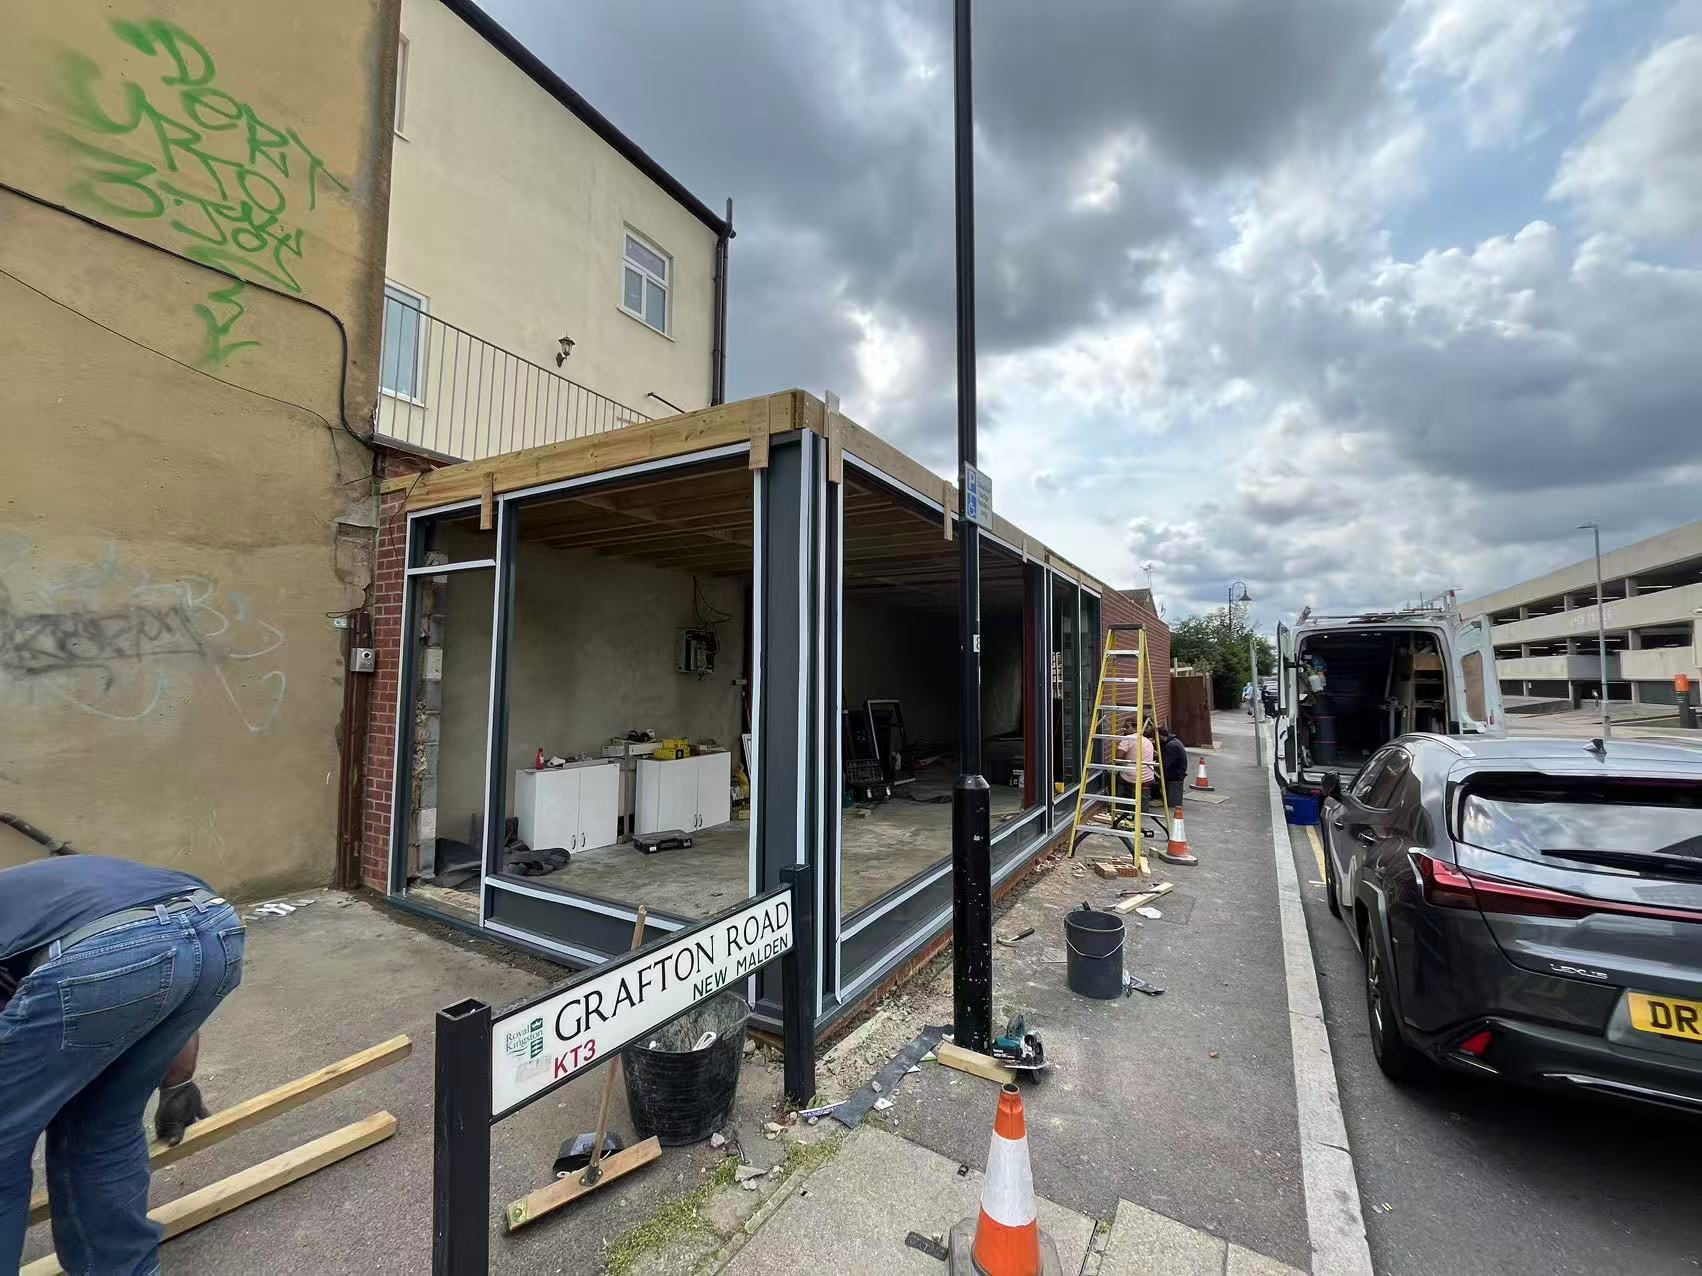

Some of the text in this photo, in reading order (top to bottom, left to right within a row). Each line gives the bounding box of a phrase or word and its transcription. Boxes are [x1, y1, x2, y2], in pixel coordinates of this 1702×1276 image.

[555, 901, 789, 1042] GRAFTON ROAD
[692, 933, 788, 1001] NEW MALDEN
[506, 1024, 530, 1043] Royal
[506, 1030, 543, 1052] Kingston
[554, 1038, 596, 1079] KT3
